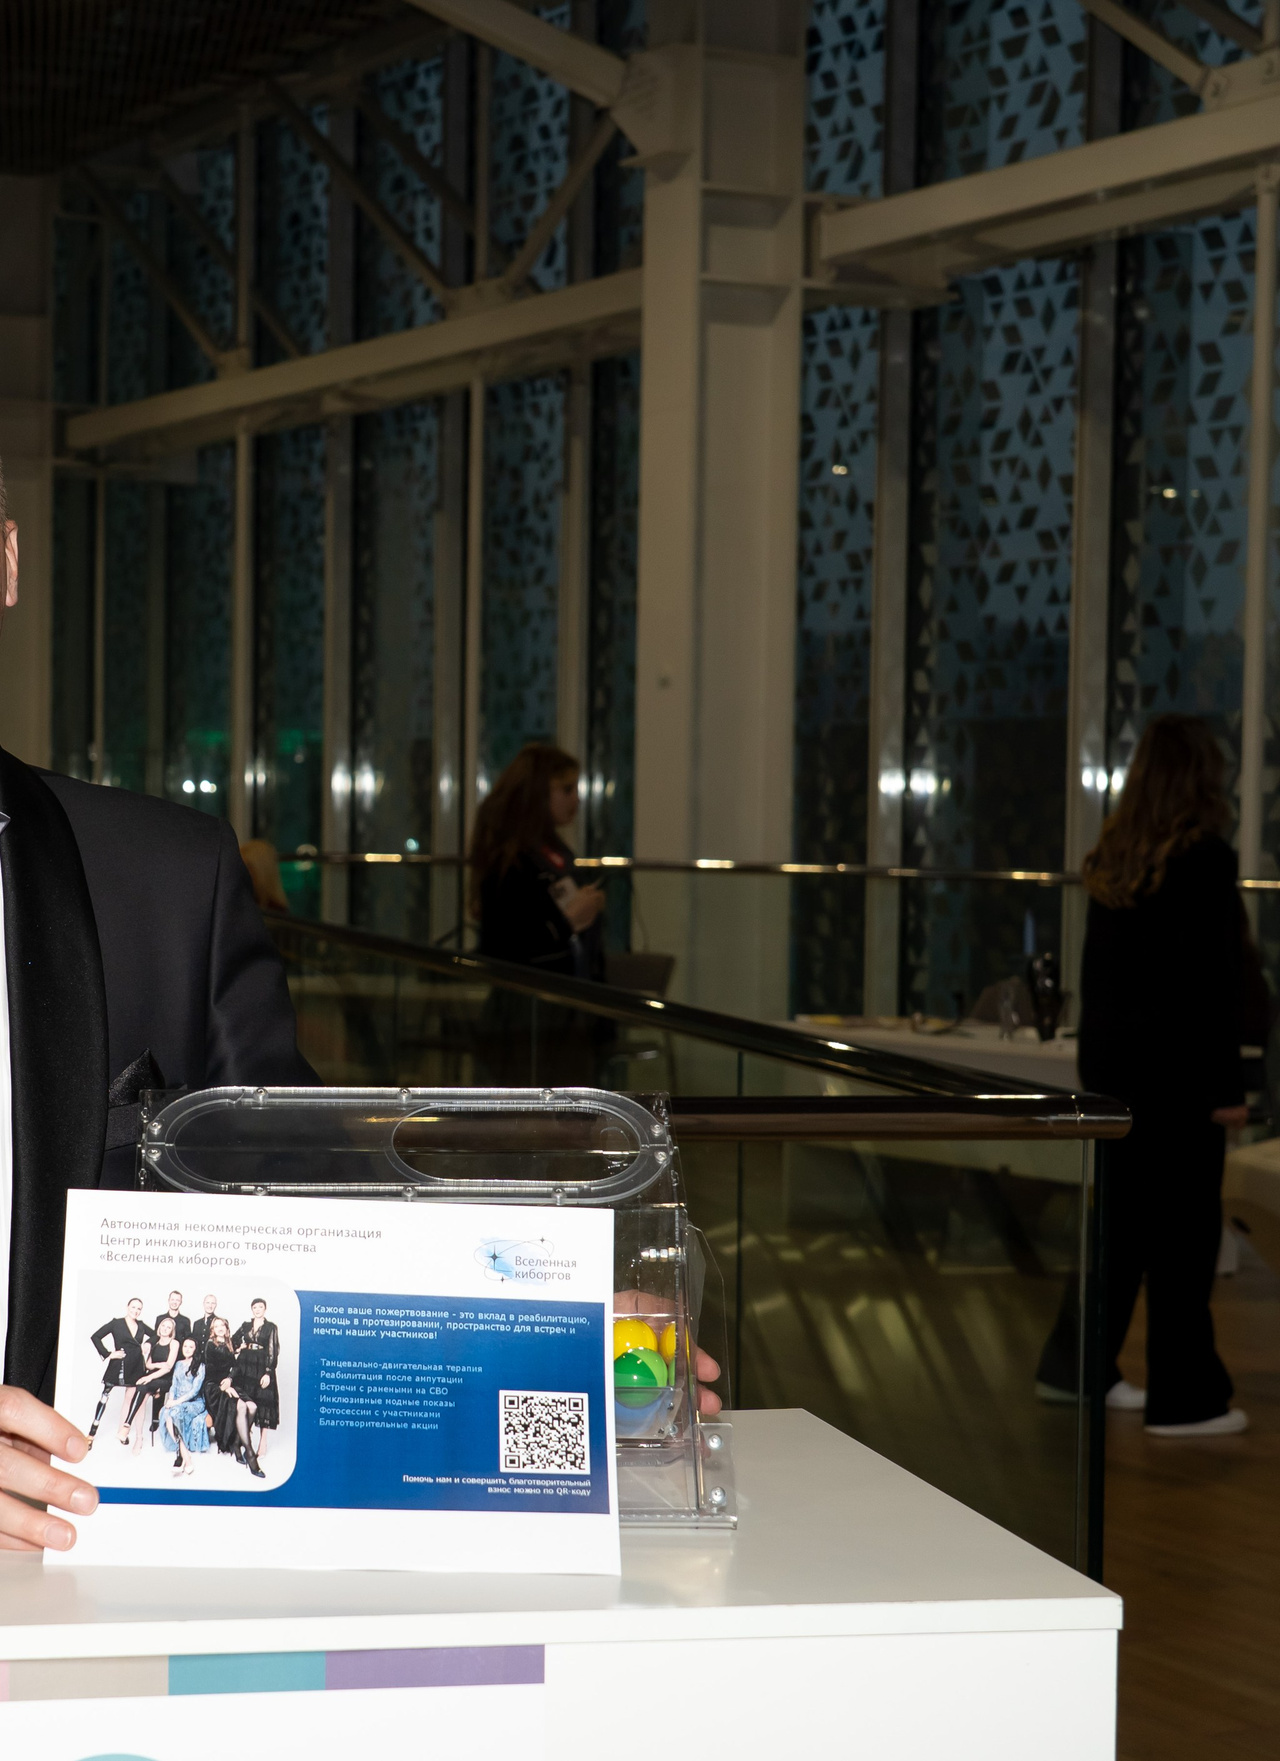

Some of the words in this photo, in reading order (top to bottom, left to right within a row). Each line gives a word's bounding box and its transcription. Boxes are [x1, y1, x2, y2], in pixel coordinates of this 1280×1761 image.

[100, 1218, 180, 1231] Автономная
[184, 1223, 293, 1236] некоммерческая
[296, 1227, 382, 1240] организация
[100, 1234, 141, 1249] Центр
[145, 1238, 241, 1250] инклюзивного
[244, 1241, 317, 1254] творчества
[99, 1250, 174, 1264] «Вселенная
[178, 1253, 247, 1268] киборгов»
[515, 1255, 577, 1268] Вселенная
[514, 1269, 571, 1282] киборгов
[313, 1304, 345, 1314] Кажое
[347, 1307, 373, 1316] ваше
[375, 1308, 450, 1319] пожертвование
[459, 1311, 475, 1320] это
[478, 1312, 507, 1322] вклад
[509, 1313, 515, 1321] в
[518, 1313, 590, 1326] реабилитацию,
[313, 1316, 351, 1326] помощь
[353, 1318, 360, 1326] в
[362, 1318, 443, 1330] протезировании,
[446, 1321, 511, 1332] пространство
[513, 1324, 531, 1333] для
[534, 1325, 567, 1335] встреч
[313, 1327, 343, 1336] мечты
[345, 1328, 377, 1337] наших
[379, 1330, 438, 1340] участников!
[320, 1358, 443, 1371] Танцевально-двигательная
[445, 1364, 483, 1373] терапия
[320, 1370, 383, 1382] Реабилитация
[385, 1374, 413, 1382] после
[414, 1375, 463, 1385] ампутации
[320, 1382, 357, 1393] Встречи
[359, 1385, 365, 1393] с
[367, 1385, 413, 1394] ранеными
[415, 1387, 426, 1395] на
[429, 1386, 449, 1396] СВО
[319, 1394, 383, 1405] Инклюзивные
[385, 1398, 420, 1407] модные
[422, 1399, 456, 1408] показы
[319, 1406, 372, 1416] Фотосессии
[374, 1409, 380, 1417] с
[382, 1410, 441, 1418] участниками
[319, 1418, 409, 1429] Благотворительные
[411, 1422, 439, 1431] акции
[402, 1474, 434, 1484] Помочь
[435, 1476, 453, 1484] нам
[461, 1477, 507, 1486] совершить
[508, 1477, 591, 1487] благотворительный
[487, 1486, 511, 1494] взнос
[556, 1487, 591, 1497] QR-коду
